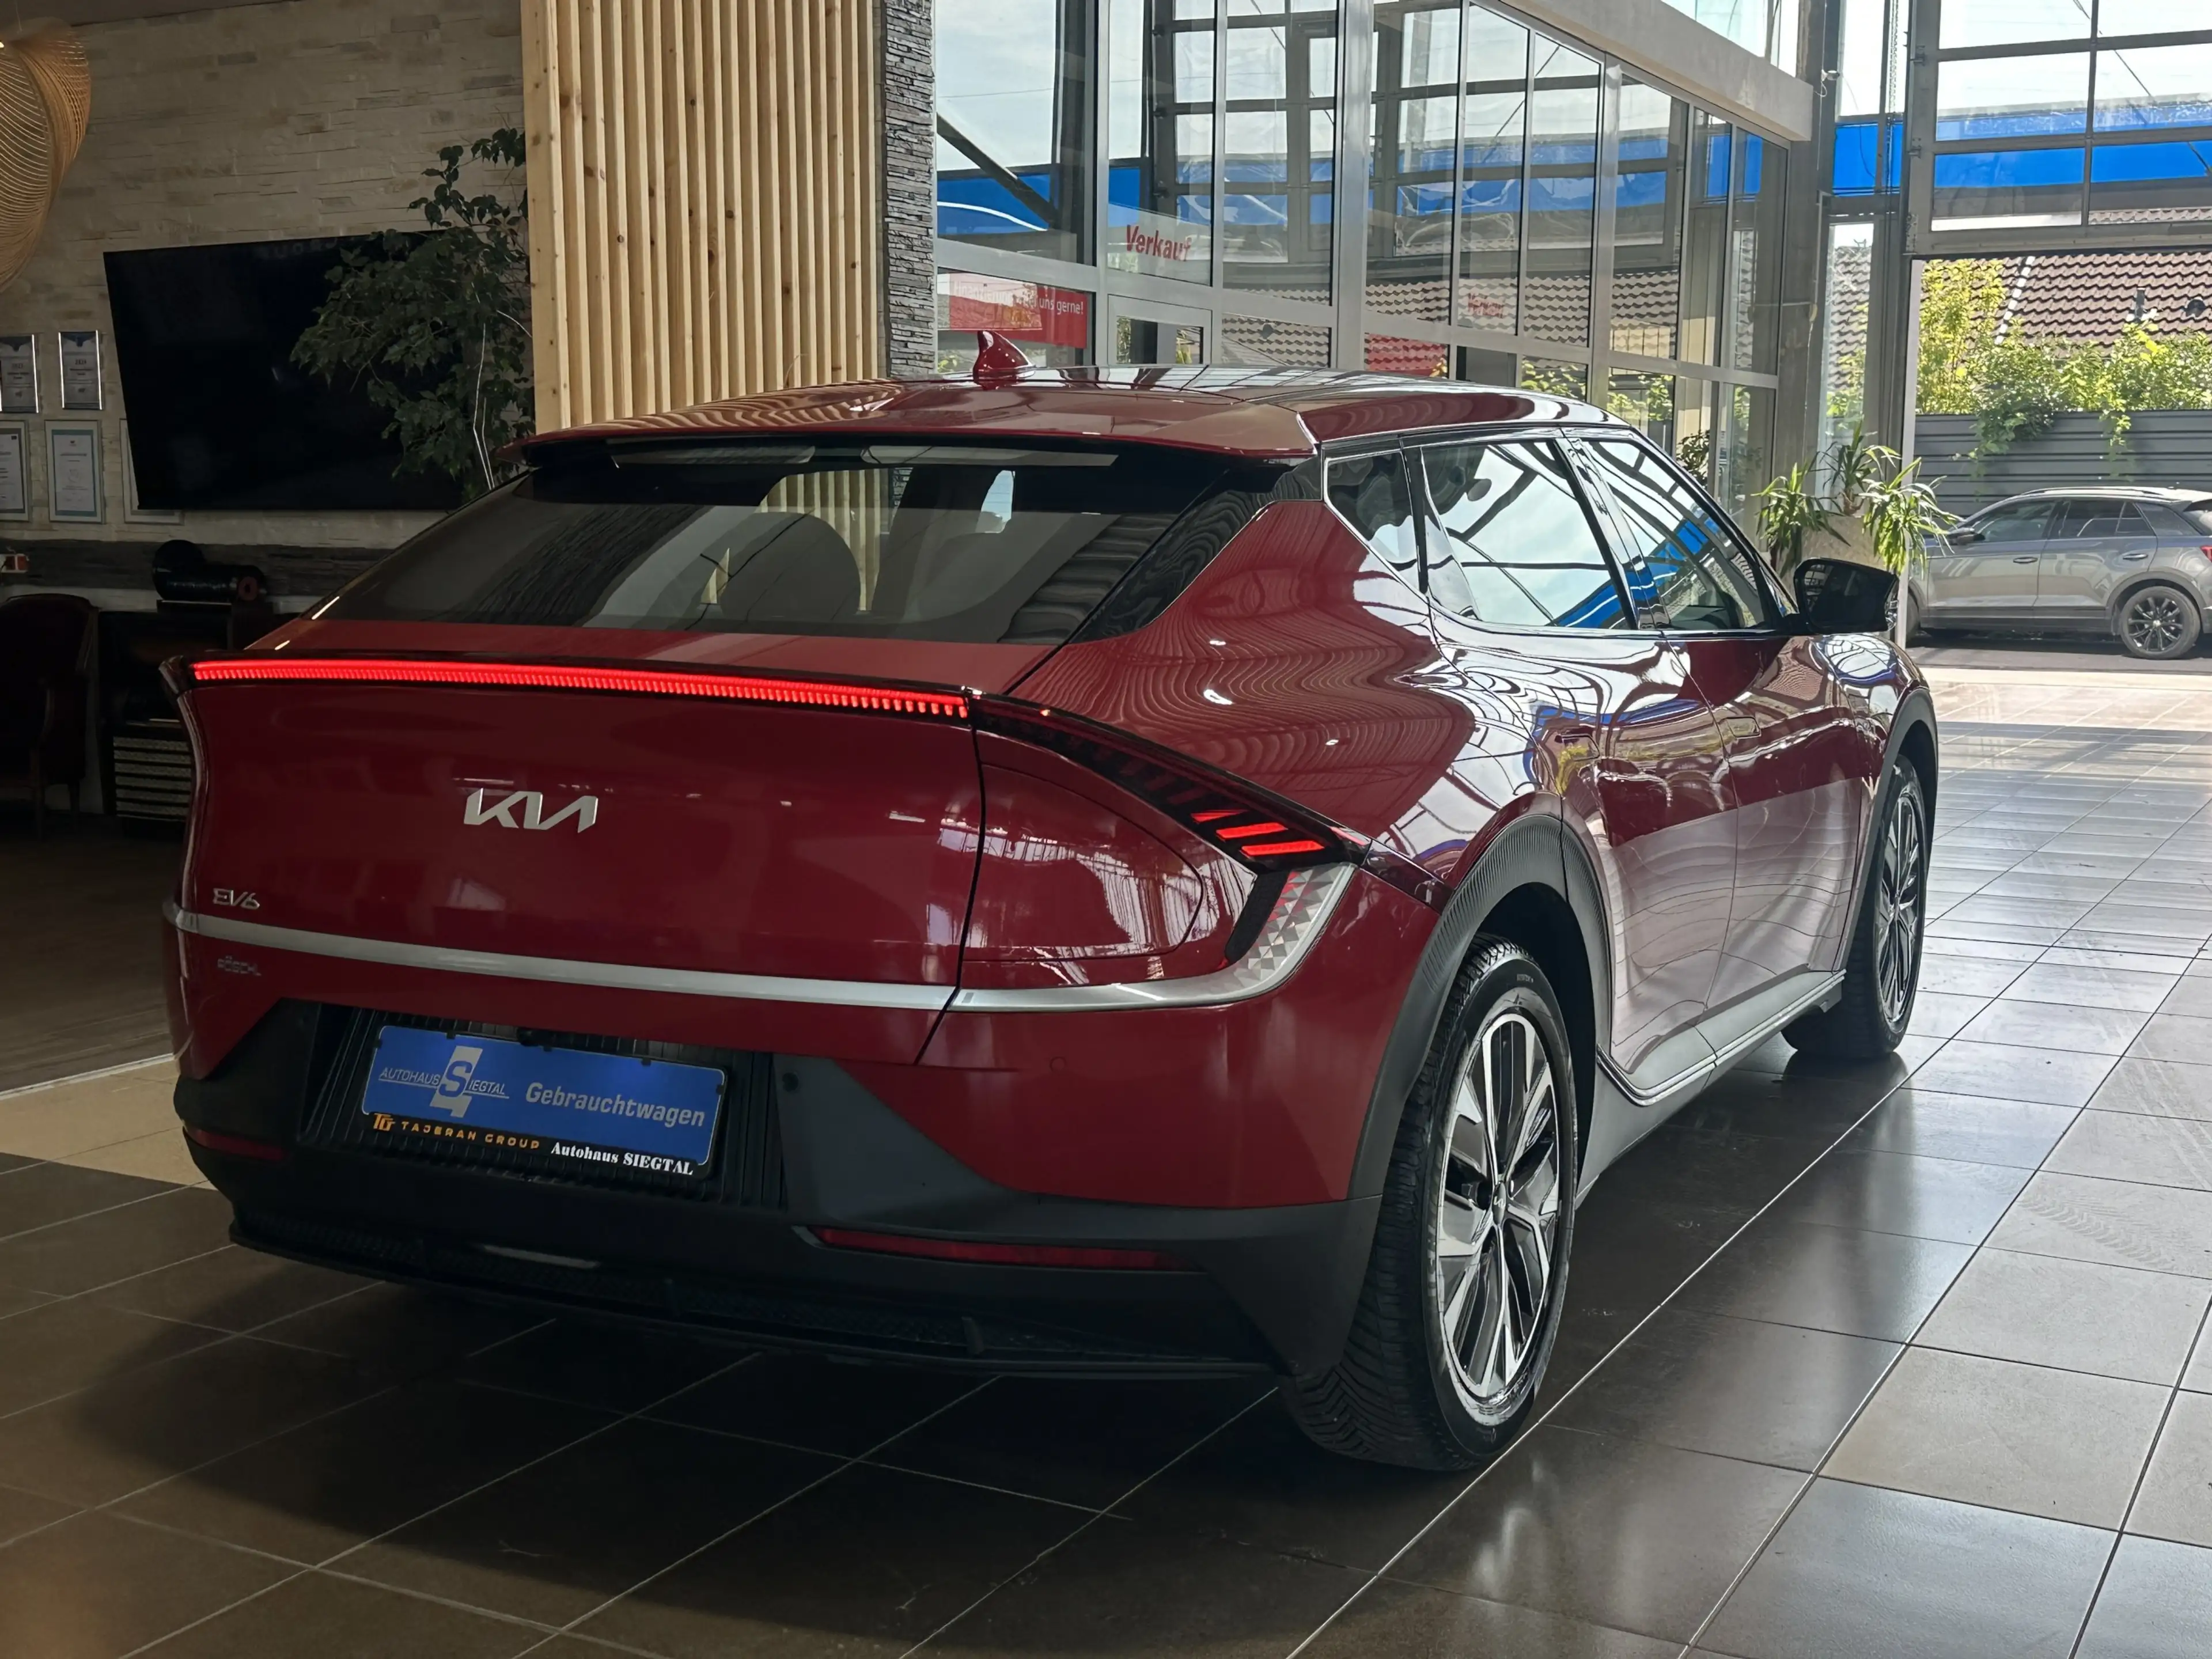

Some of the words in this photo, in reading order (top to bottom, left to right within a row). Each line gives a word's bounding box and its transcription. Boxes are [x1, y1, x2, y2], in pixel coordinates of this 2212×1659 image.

[1126, 224, 1192, 262] Verkauf
[1039, 298, 1054, 310] uns
[1056, 301, 1084, 315] gerne!
[464, 787, 599, 834] KIA
[213, 888, 260, 910] EV6
[378, 1066, 441, 1085] AUTOHAUS
[525, 1081, 705, 1128] Gebrauchtwagen
[484, 1132, 540, 1150] GROUP
[551, 1141, 619, 1164] Autohaus
[622, 1152, 694, 1176] SIEGTAL
